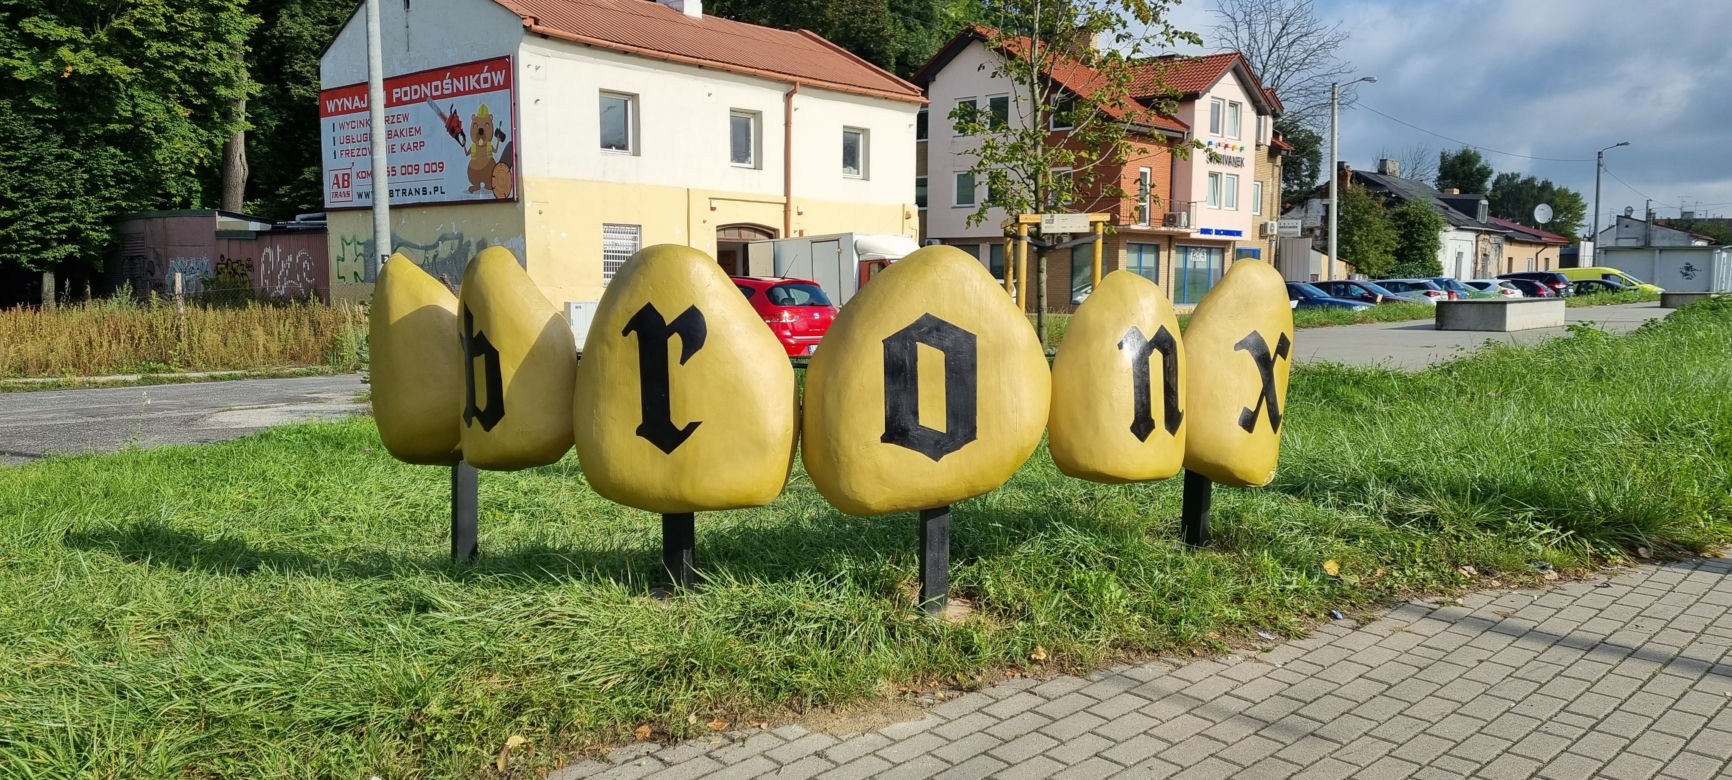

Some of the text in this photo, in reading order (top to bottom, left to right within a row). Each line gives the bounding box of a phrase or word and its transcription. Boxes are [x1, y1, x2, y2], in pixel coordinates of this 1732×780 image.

[326, 65, 506, 113] WYNAJ PODNOŚNIKÓW
[338, 112, 410, 131] WYCINK RZEW
[385, 126, 422, 141] BAKIEM
[400, 140, 426, 154] KARP
[400, 163, 420, 176] 009
[423, 161, 445, 174] 009
[332, 172, 351, 190] AB
[331, 190, 351, 199] TRANS
